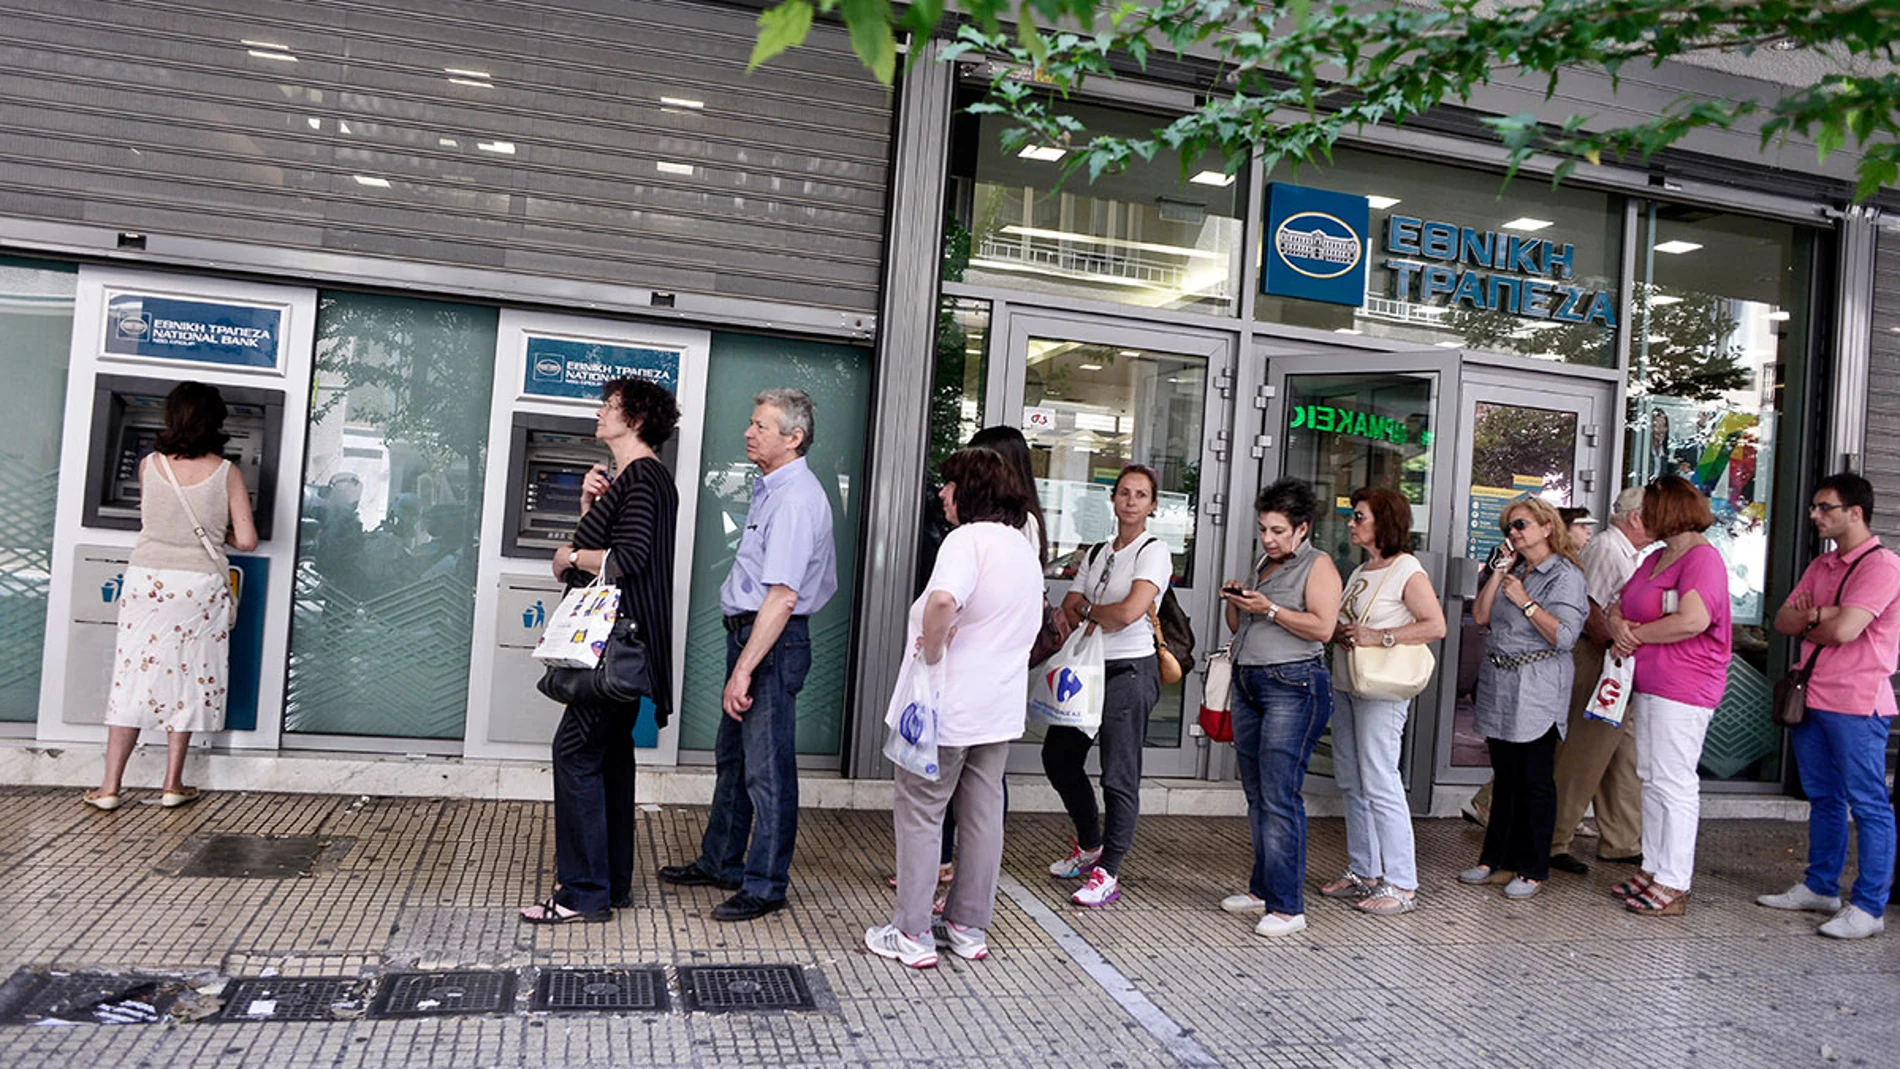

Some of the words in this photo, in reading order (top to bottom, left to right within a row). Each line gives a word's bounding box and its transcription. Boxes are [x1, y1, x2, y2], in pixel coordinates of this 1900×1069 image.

[1389, 214, 1574, 280] ΕΘΝΙΚΗ
[1387, 258, 1617, 328] ΤΡΑΠΕΖΑ
[153, 329, 218, 344] NATIONAL
[221, 335, 259, 348] BANK
[154, 319, 206, 333] ΕΘΝΙΚΗ
[208, 324, 271, 340] ΤΡΑΠΕΖΑ
[566, 361, 612, 374] ΕΘΝΙΚΗ
[615, 366, 671, 380] ΤΡΑΠΕΖΑ
